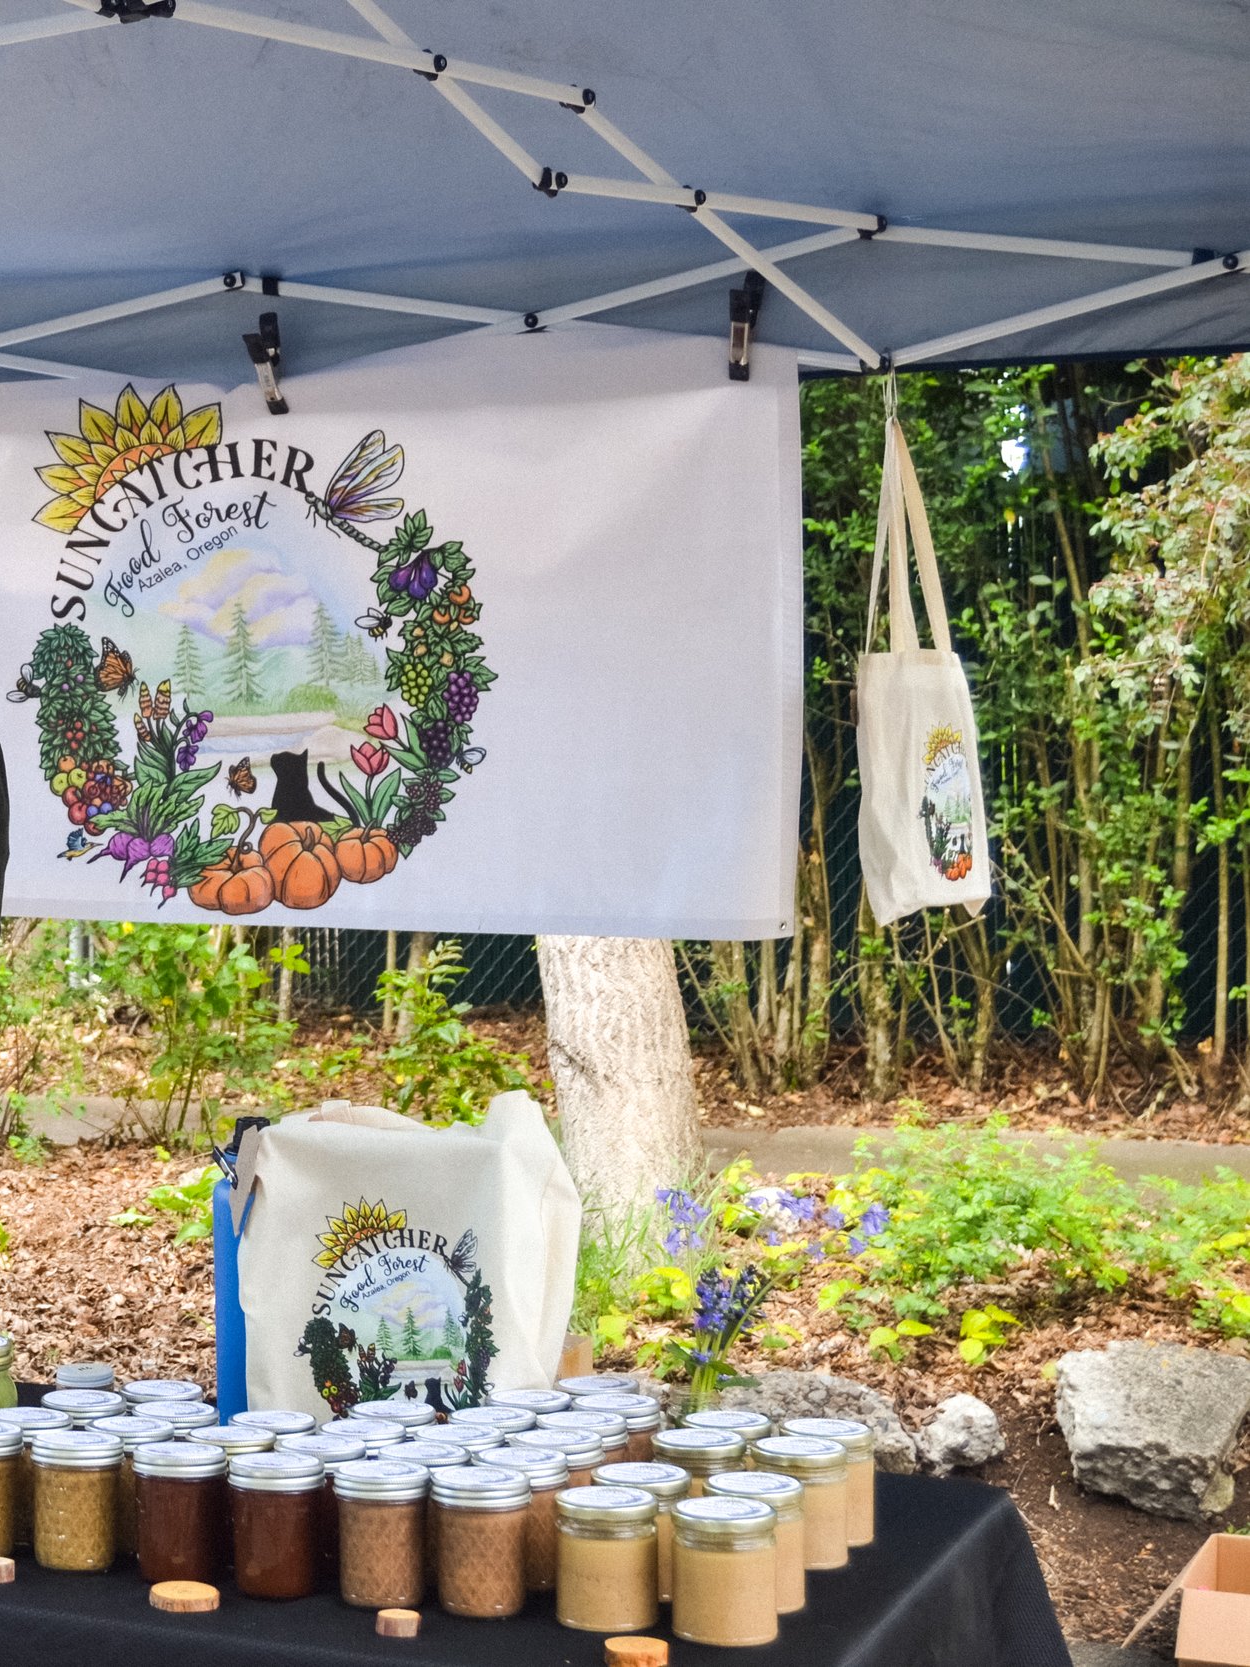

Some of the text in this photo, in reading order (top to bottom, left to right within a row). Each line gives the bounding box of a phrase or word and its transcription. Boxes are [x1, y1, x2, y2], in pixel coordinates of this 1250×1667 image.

[50, 438, 315, 622] SUNCATCHER
[103, 490, 277, 618] Food Forest
[137, 525, 239, 593] Azalea, Oregon
[311, 1228, 448, 1316] SUNCATCHER
[339, 1251, 430, 1313] Food Forest
[361, 1269, 411, 1300] Azalea, Oregon
